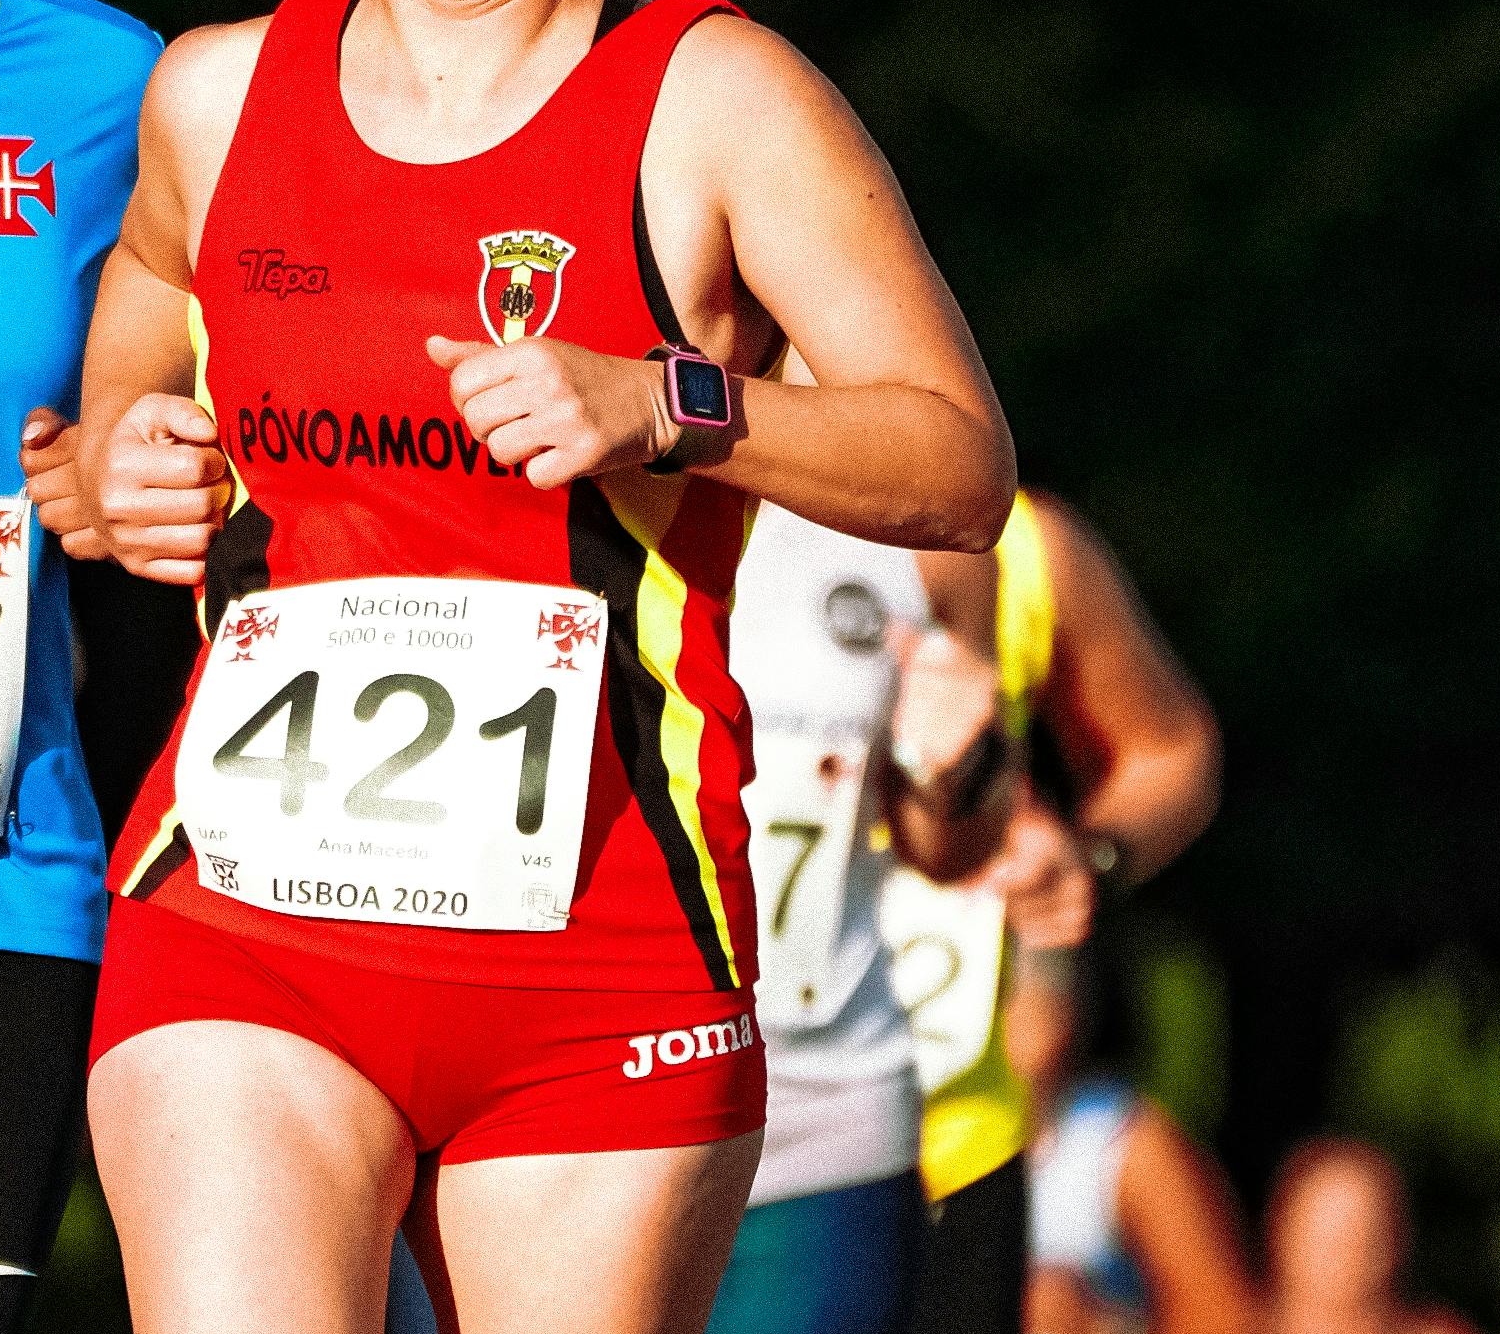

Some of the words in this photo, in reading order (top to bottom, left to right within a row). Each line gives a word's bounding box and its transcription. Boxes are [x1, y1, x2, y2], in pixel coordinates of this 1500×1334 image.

[339, 593, 470, 621] Nacional
[325, 627, 378, 650] 5000
[404, 628, 474, 651] 10000
[212, 669, 558, 836] 421
[317, 837, 352, 855] Ana
[521, 854, 553, 869] V45
[766, 820, 827, 938] 7
[271, 877, 381, 912] LISBOA
[391, 886, 470, 918] 2020
